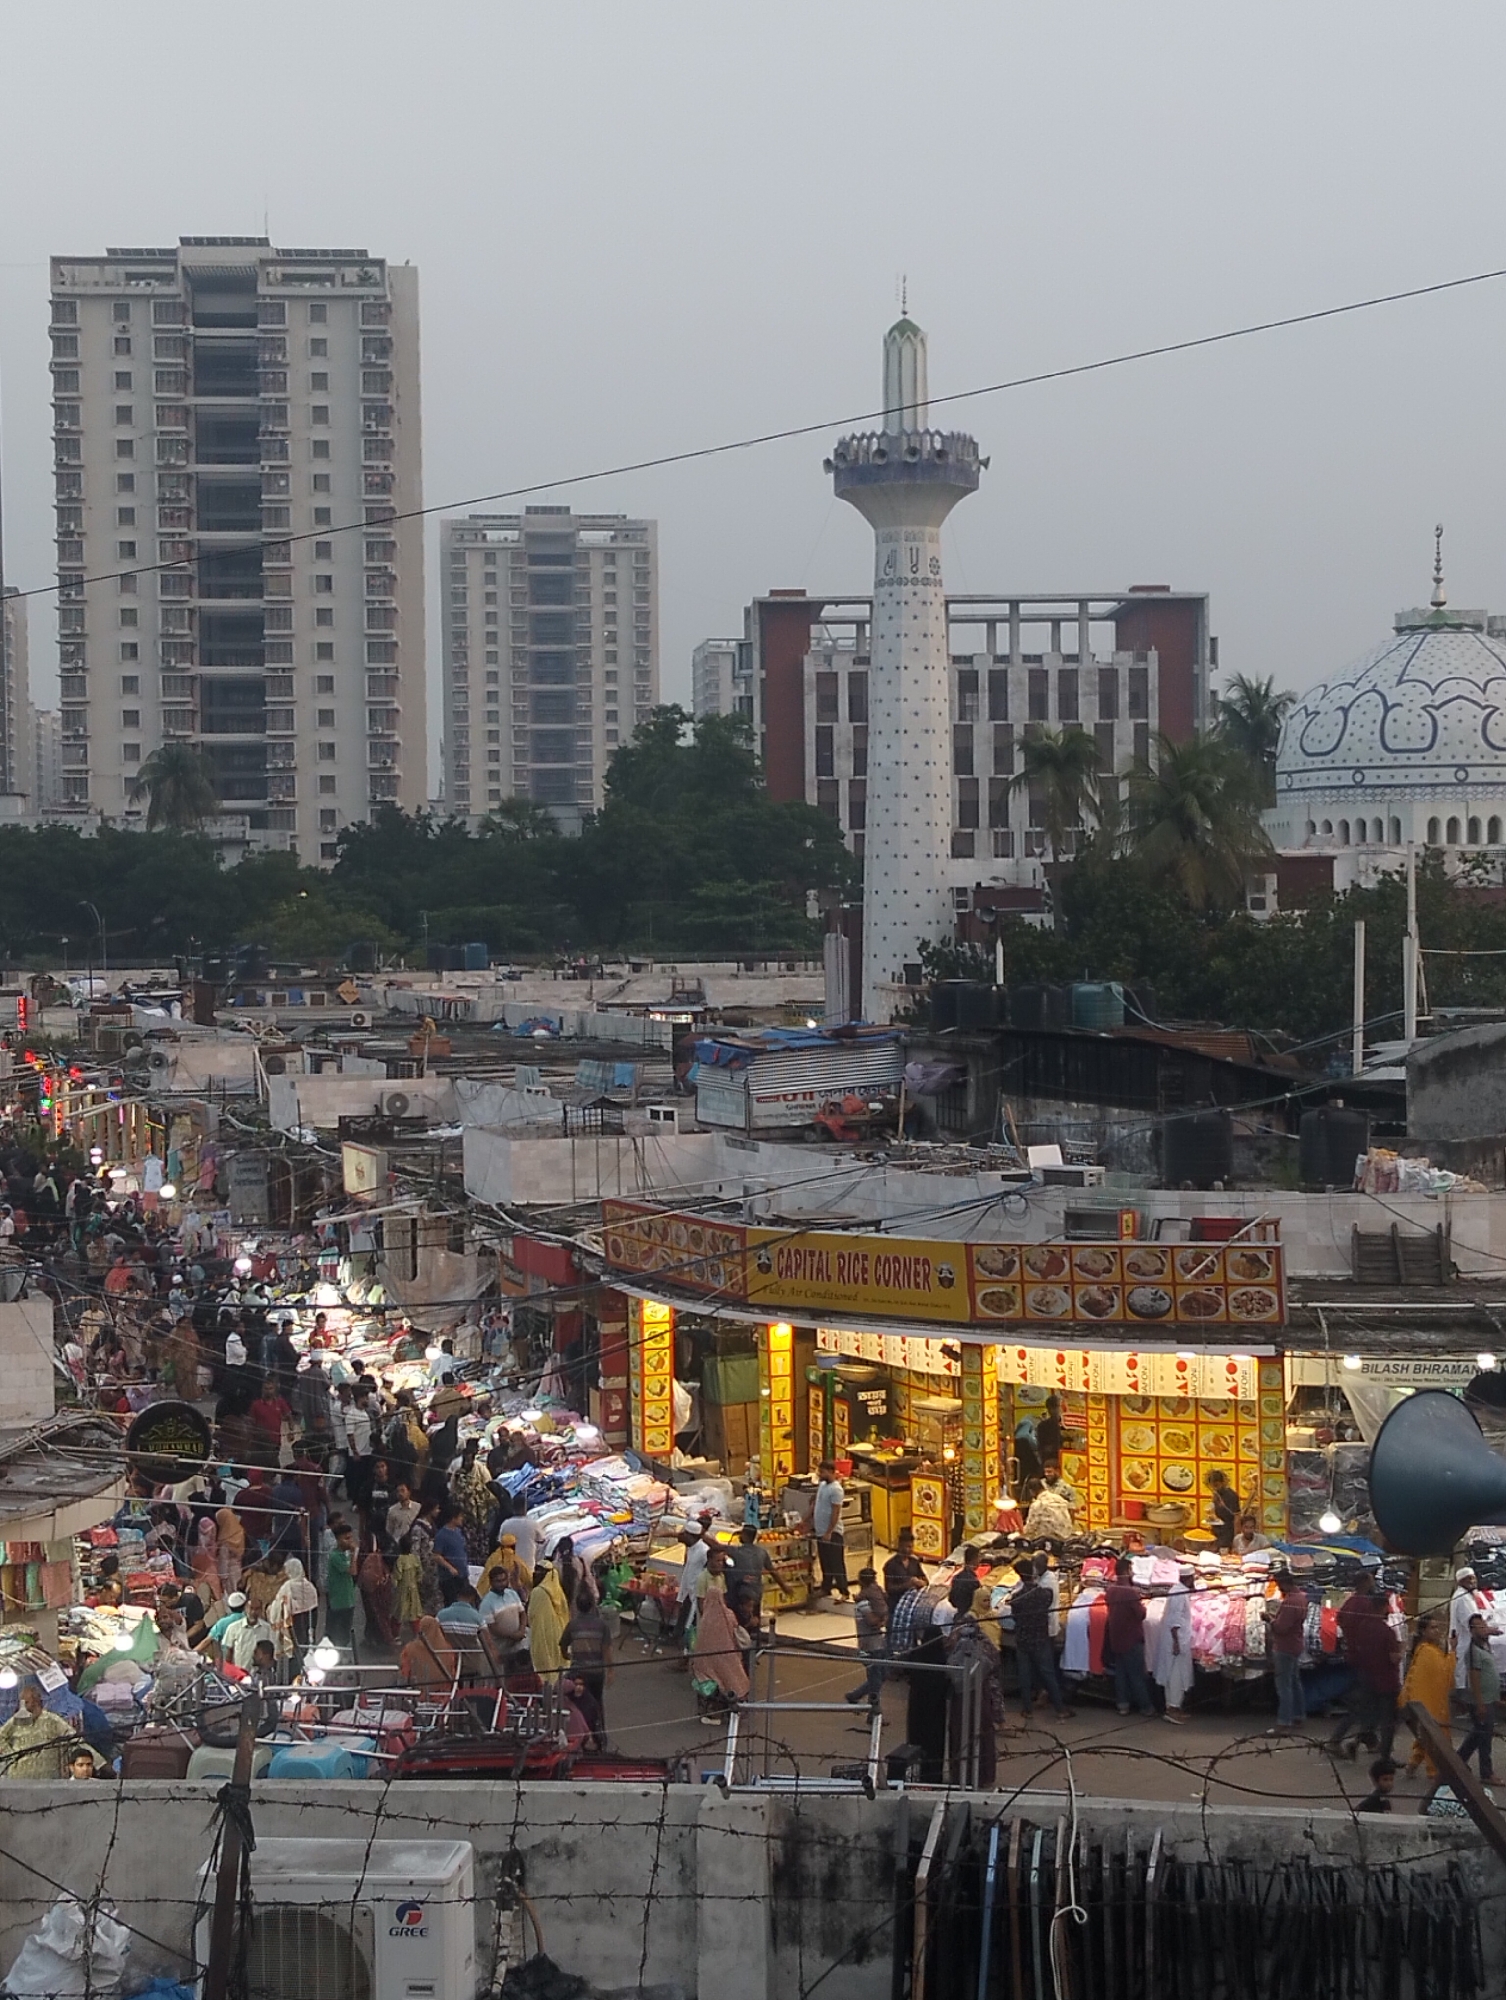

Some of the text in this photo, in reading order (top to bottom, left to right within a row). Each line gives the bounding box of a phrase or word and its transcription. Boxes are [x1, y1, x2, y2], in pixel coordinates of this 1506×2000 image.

[777, 1247, 932, 1293] CAPITAL RICE CORNER
[787, 1286, 803, 1298] Air
[804, 1288, 859, 1301] Conditioned
[1361, 1363, 1481, 1376] BILASH BHRAMAN
[389, 1926, 429, 1937] GREE
